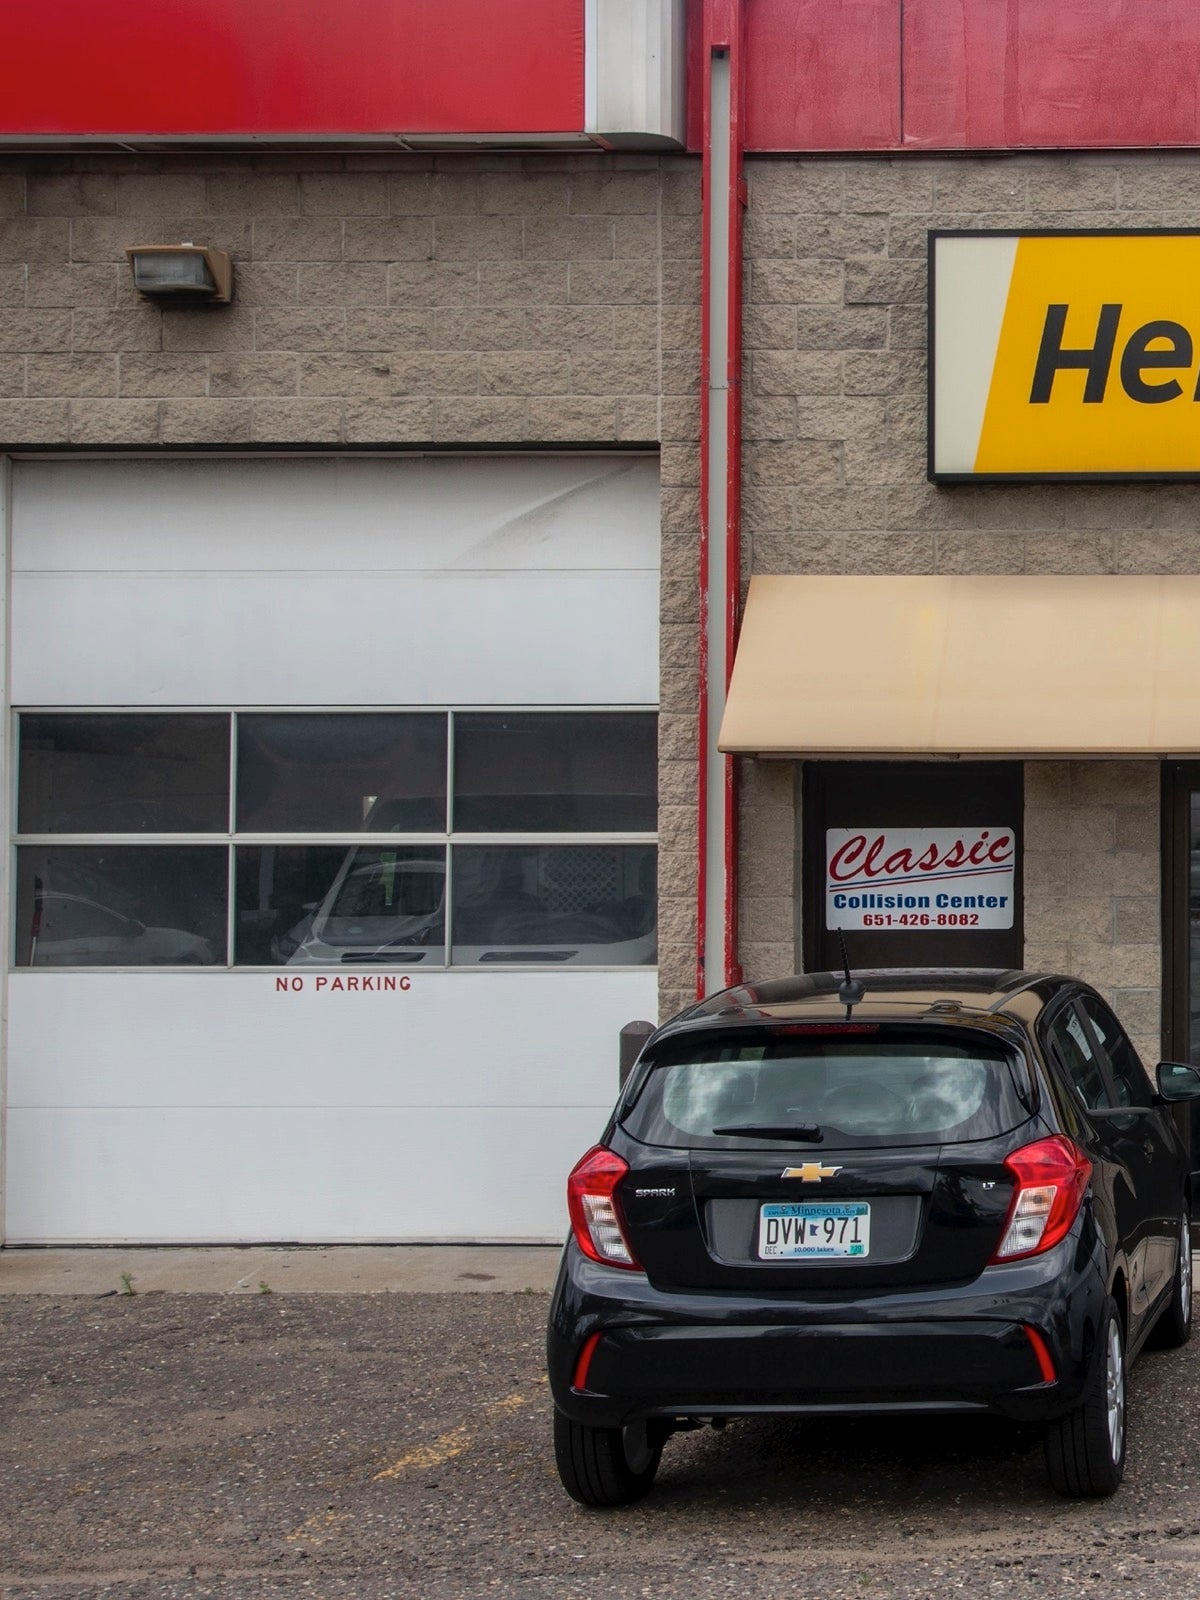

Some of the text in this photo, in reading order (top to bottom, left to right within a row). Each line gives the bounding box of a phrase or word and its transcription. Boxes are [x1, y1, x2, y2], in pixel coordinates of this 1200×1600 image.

[829, 831, 1014, 881] Classic
[833, 893, 1009, 910] Collision Center
[862, 913, 980, 927] 651-426-8082
[275, 975, 412, 992] NO PARKING
[635, 1187, 676, 1198] SPARK
[982, 1181, 996, 1190] LT
[766, 1216, 862, 1245] DVW 971
[764, 1245, 778, 1255] DEC
